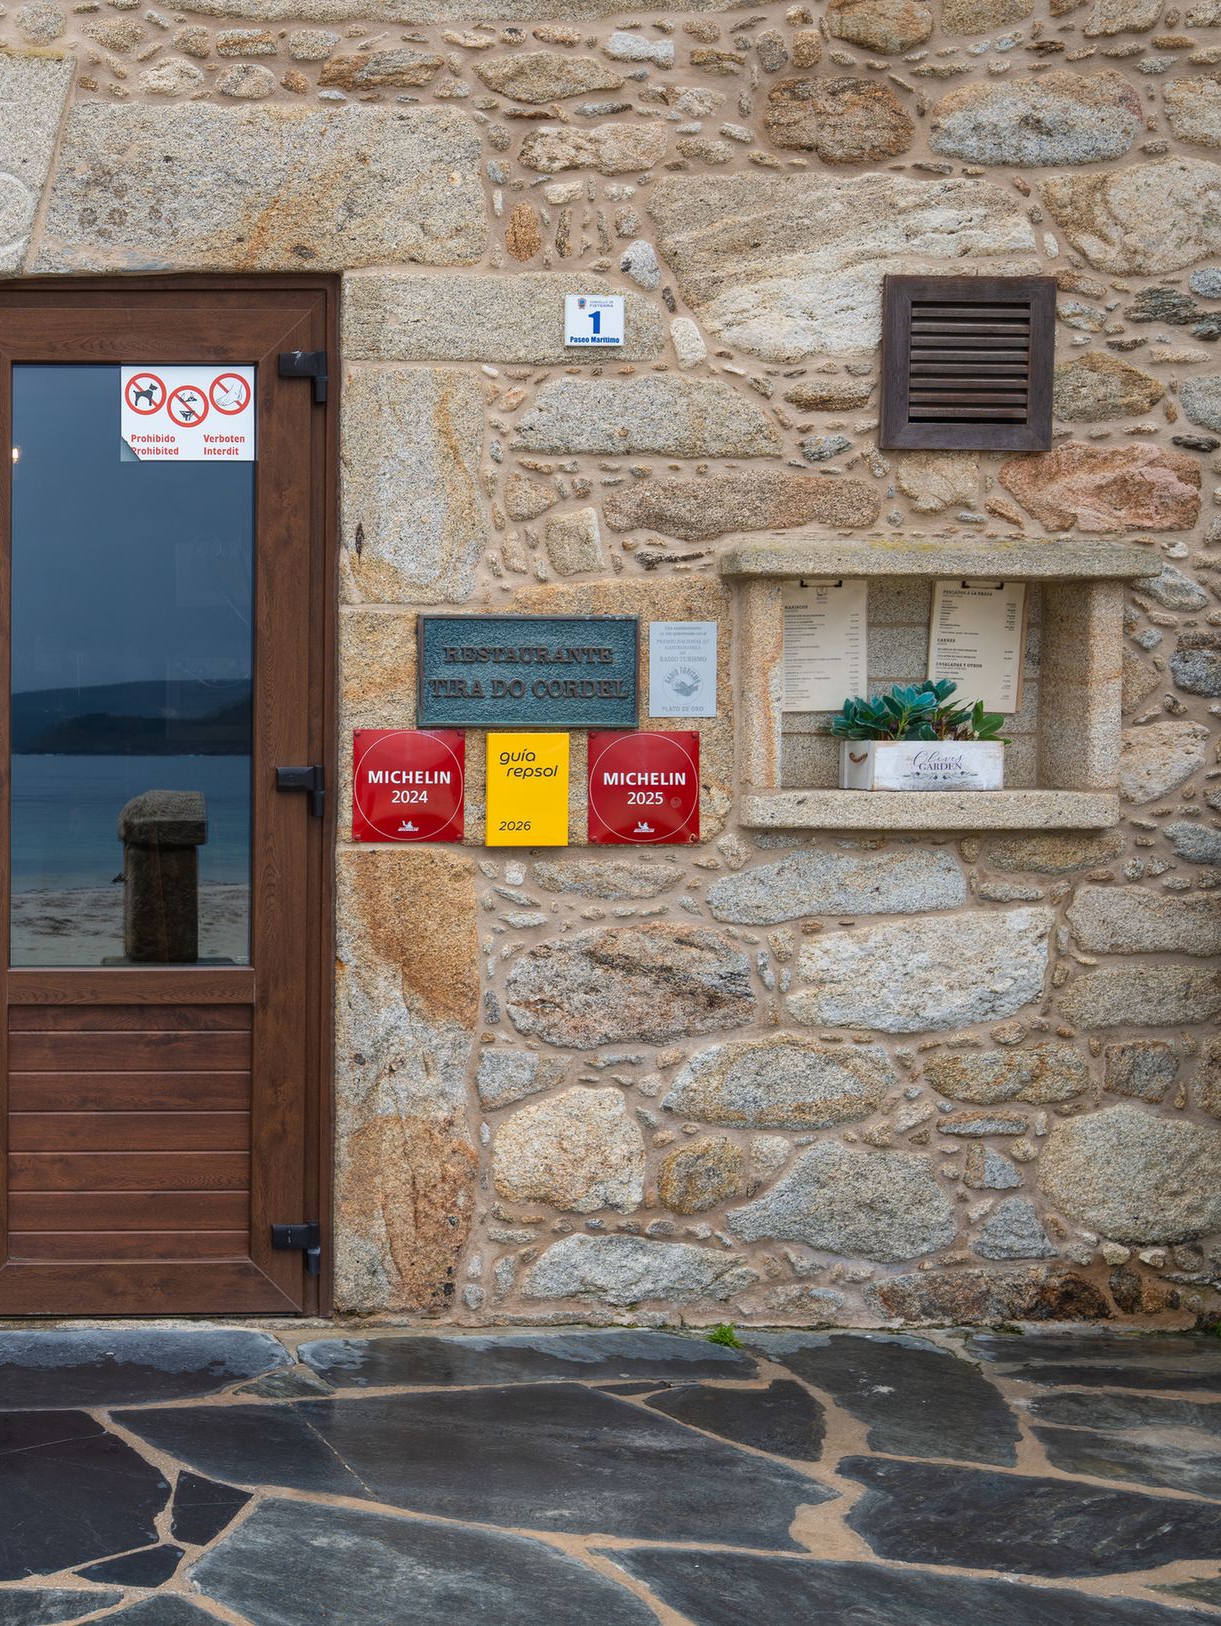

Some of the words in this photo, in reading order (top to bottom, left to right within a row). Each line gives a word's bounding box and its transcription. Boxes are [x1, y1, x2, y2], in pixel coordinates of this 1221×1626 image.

[588, 311, 600, 334] 1
[131, 434, 176, 443] Prohibido
[203, 434, 246, 443] Verboten
[203, 446, 240, 456] Interdit
[444, 646, 614, 664] RESTAURANTE
[430, 679, 485, 698] TIRA
[492, 679, 526, 698] DO
[532, 678, 629, 698] CORDEL
[499, 748, 536, 766] guía
[913, 750, 964, 768] Olives
[506, 765, 559, 780] repsol
[918, 762, 963, 771] GARDEN
[368, 770, 451, 785] MICHELIN
[603, 772, 686, 786] MICHELIN
[391, 790, 429, 804] 2024
[627, 791, 664, 805] 2025
[498, 820, 532, 832] 2026
